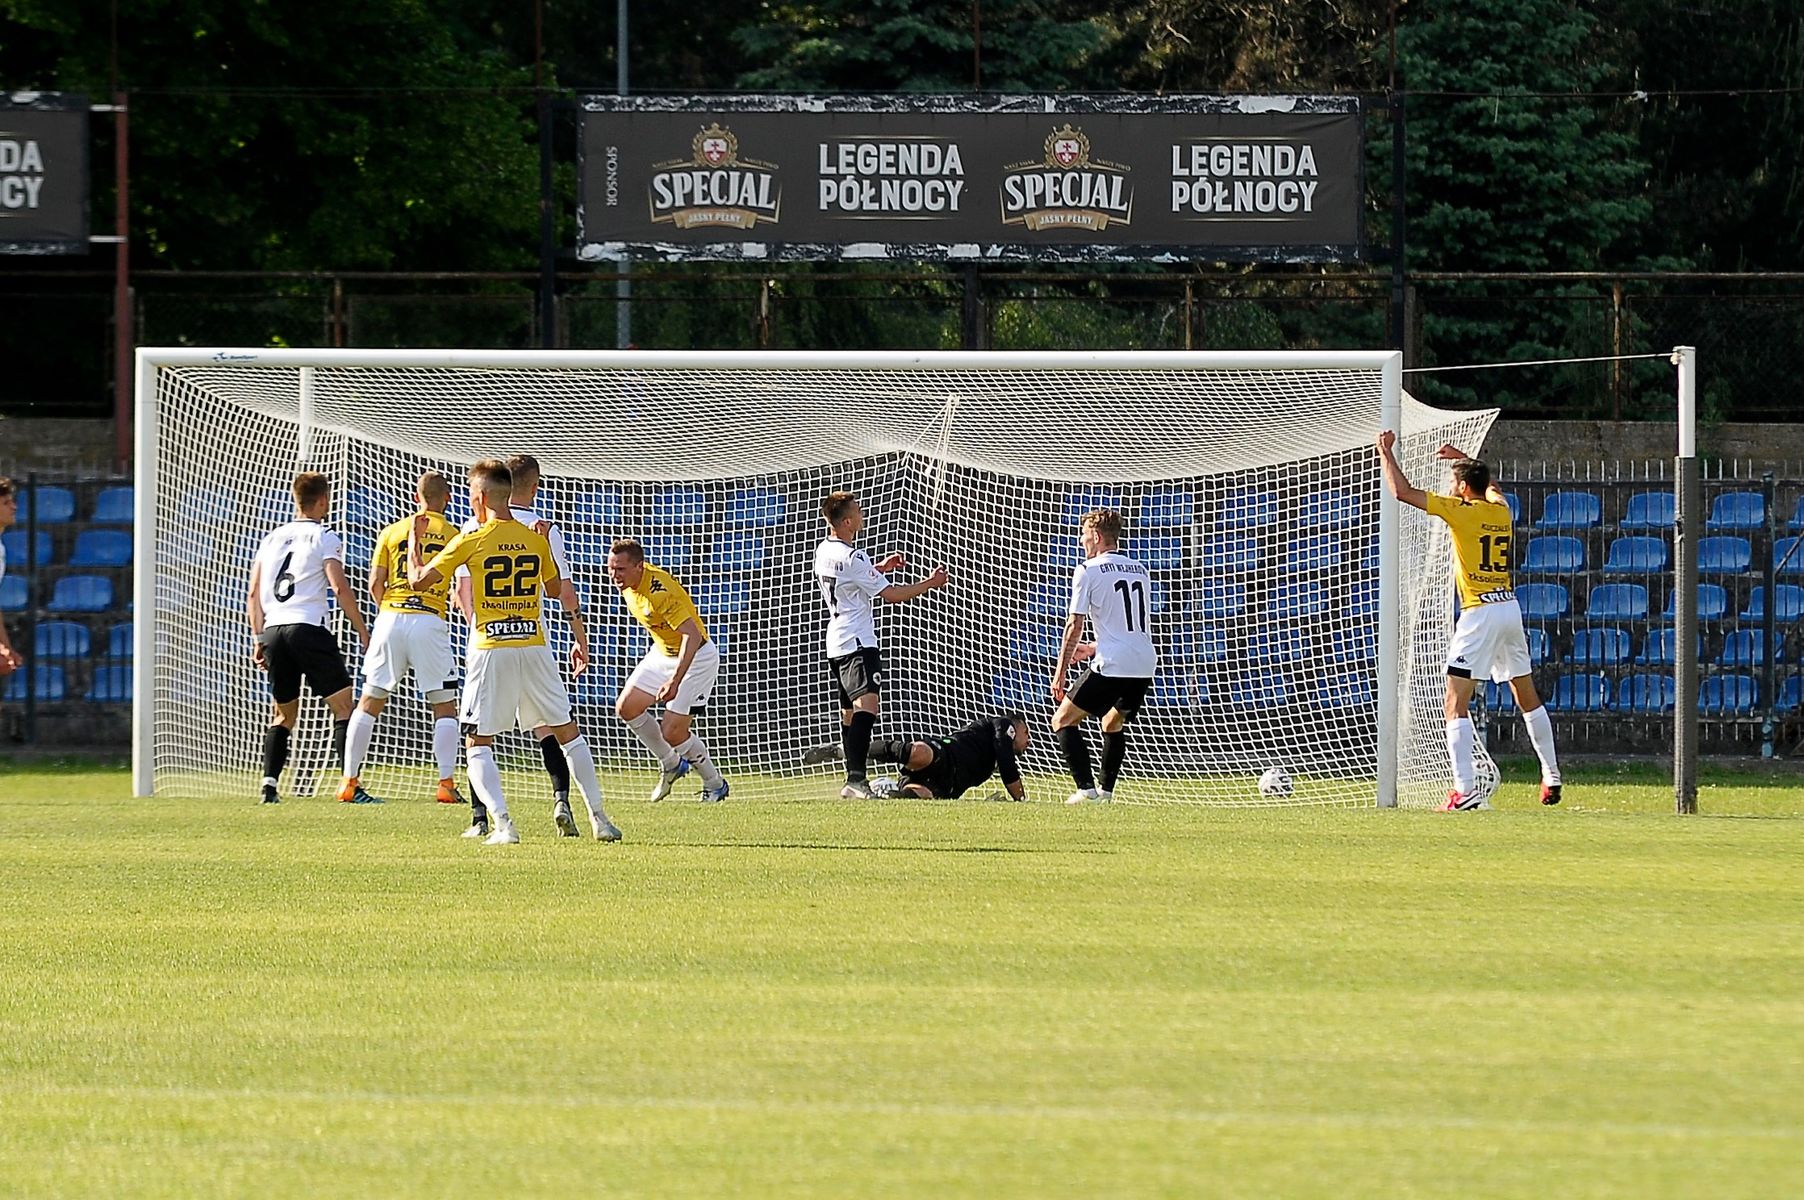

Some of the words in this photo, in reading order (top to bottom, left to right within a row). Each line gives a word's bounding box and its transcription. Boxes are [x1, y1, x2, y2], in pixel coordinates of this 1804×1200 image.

[606, 146, 618, 206] SPONSOR
[819, 143, 965, 175] LEGENDA
[1172, 145, 1318, 176] LEGENDA
[0, 175, 44, 209] CY
[652, 170, 776, 210] SPECJAL
[819, 175, 965, 210] PÓŁNOCY
[1004, 171, 1128, 212] SPECJAL
[1172, 177, 1318, 212] PÓŁNOCY
[421, 532, 446, 541] TYKA
[498, 543, 527, 552] KRASA
[1479, 534, 1510, 572] 13
[273, 551, 296, 603] 6
[483, 554, 540, 597] 22
[1113, 579, 1146, 633] 11
